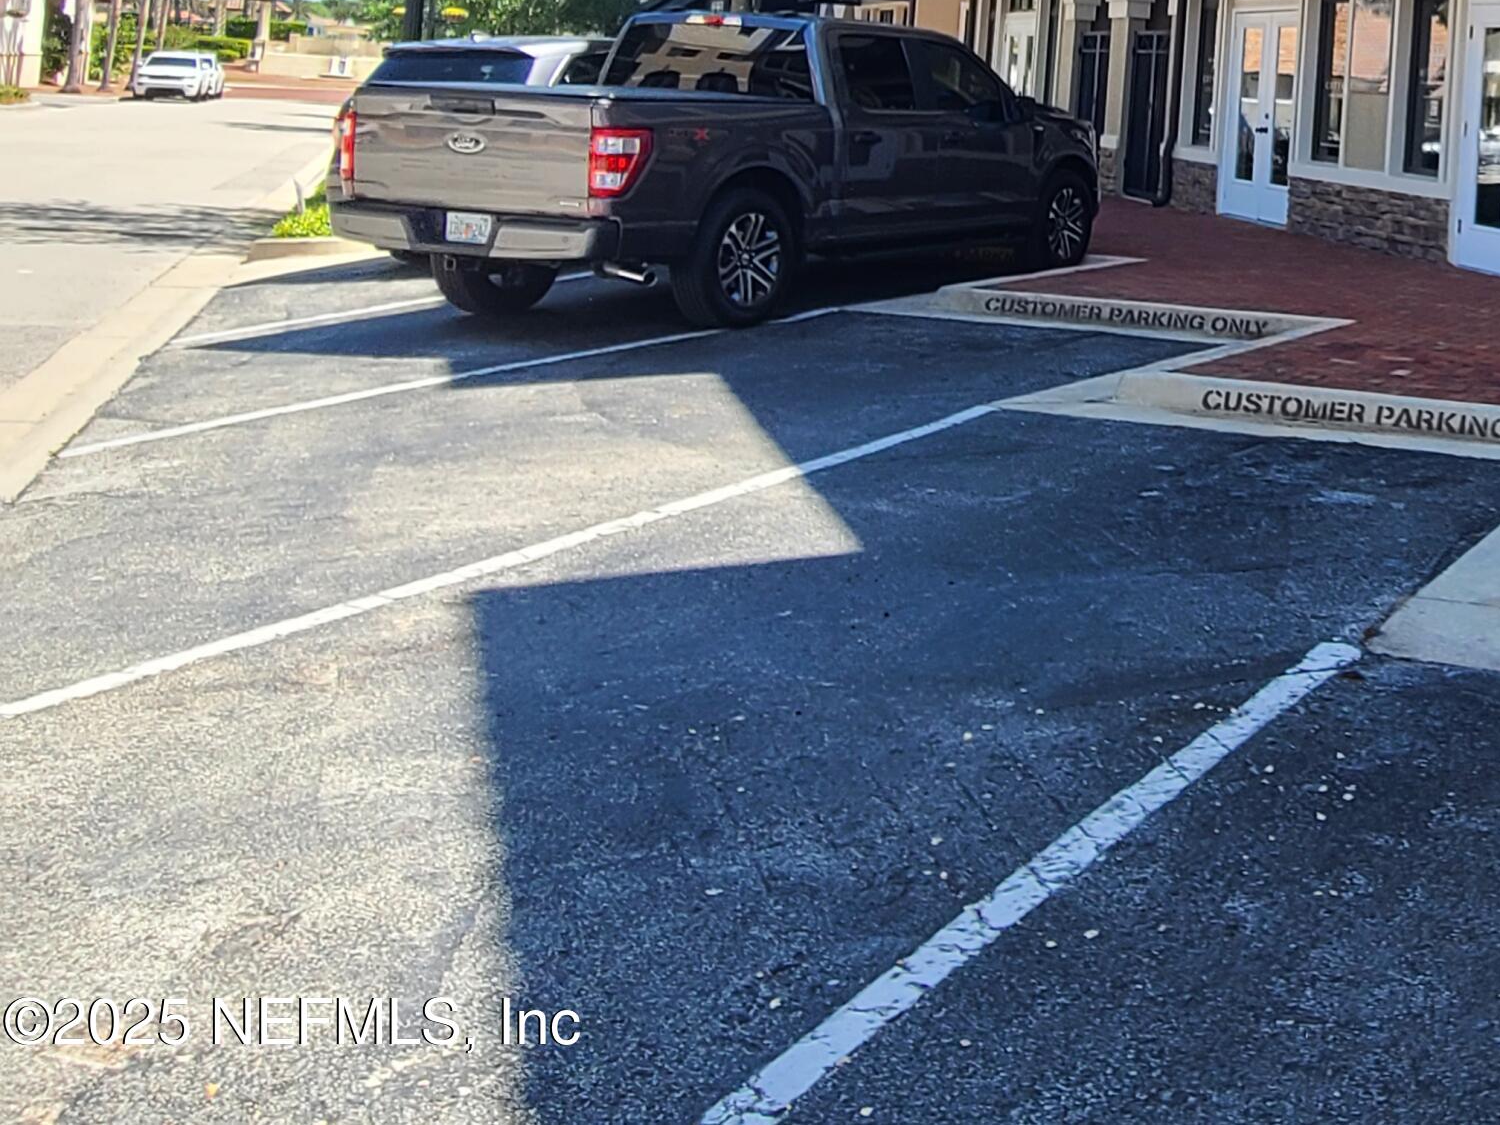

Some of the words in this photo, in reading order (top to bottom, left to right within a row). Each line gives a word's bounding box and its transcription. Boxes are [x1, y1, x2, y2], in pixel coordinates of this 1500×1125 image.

[985, 296, 1102, 322] CUSTOMER
[1108, 307, 1206, 332] PARKING
[1210, 317, 1270, 336] ONLY
[1201, 388, 1366, 424] CUSTOMER
